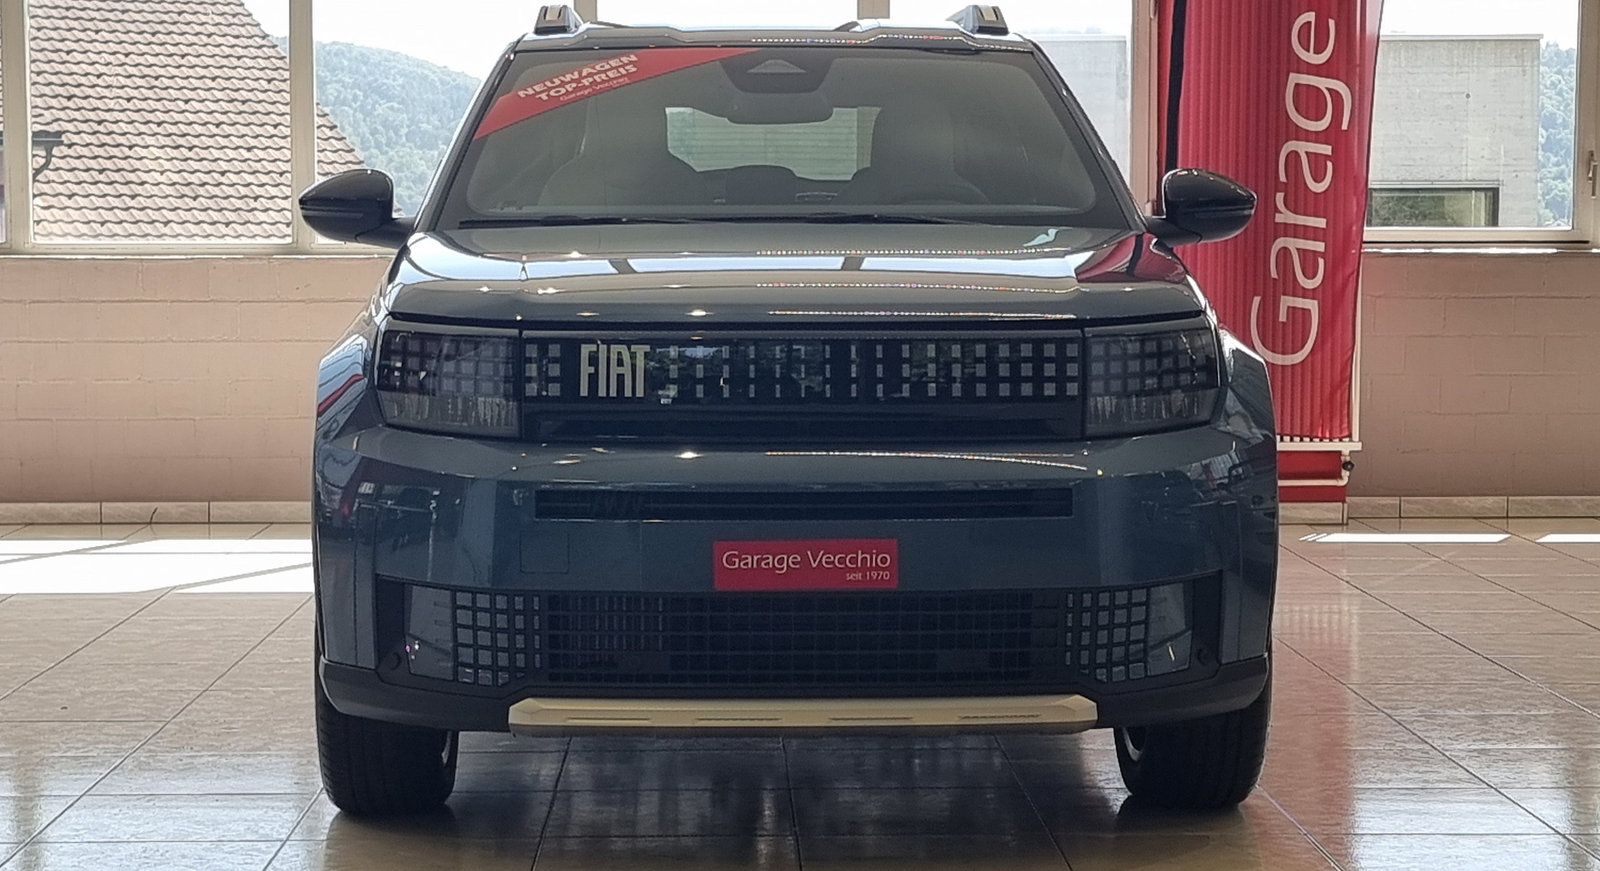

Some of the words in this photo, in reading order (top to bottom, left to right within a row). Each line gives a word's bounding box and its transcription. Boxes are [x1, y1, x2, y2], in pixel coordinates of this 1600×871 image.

[517, 54, 639, 98] NEUWAGEN
[535, 64, 638, 101] TOP-PREIS
[1250, 11, 1352, 366] Garage
[579, 343, 651, 398] FIAT
[722, 550, 801, 574] Garage
[806, 549, 891, 568] Vecchio
[845, 571, 862, 581] seit
[866, 570, 891, 581] 1970
